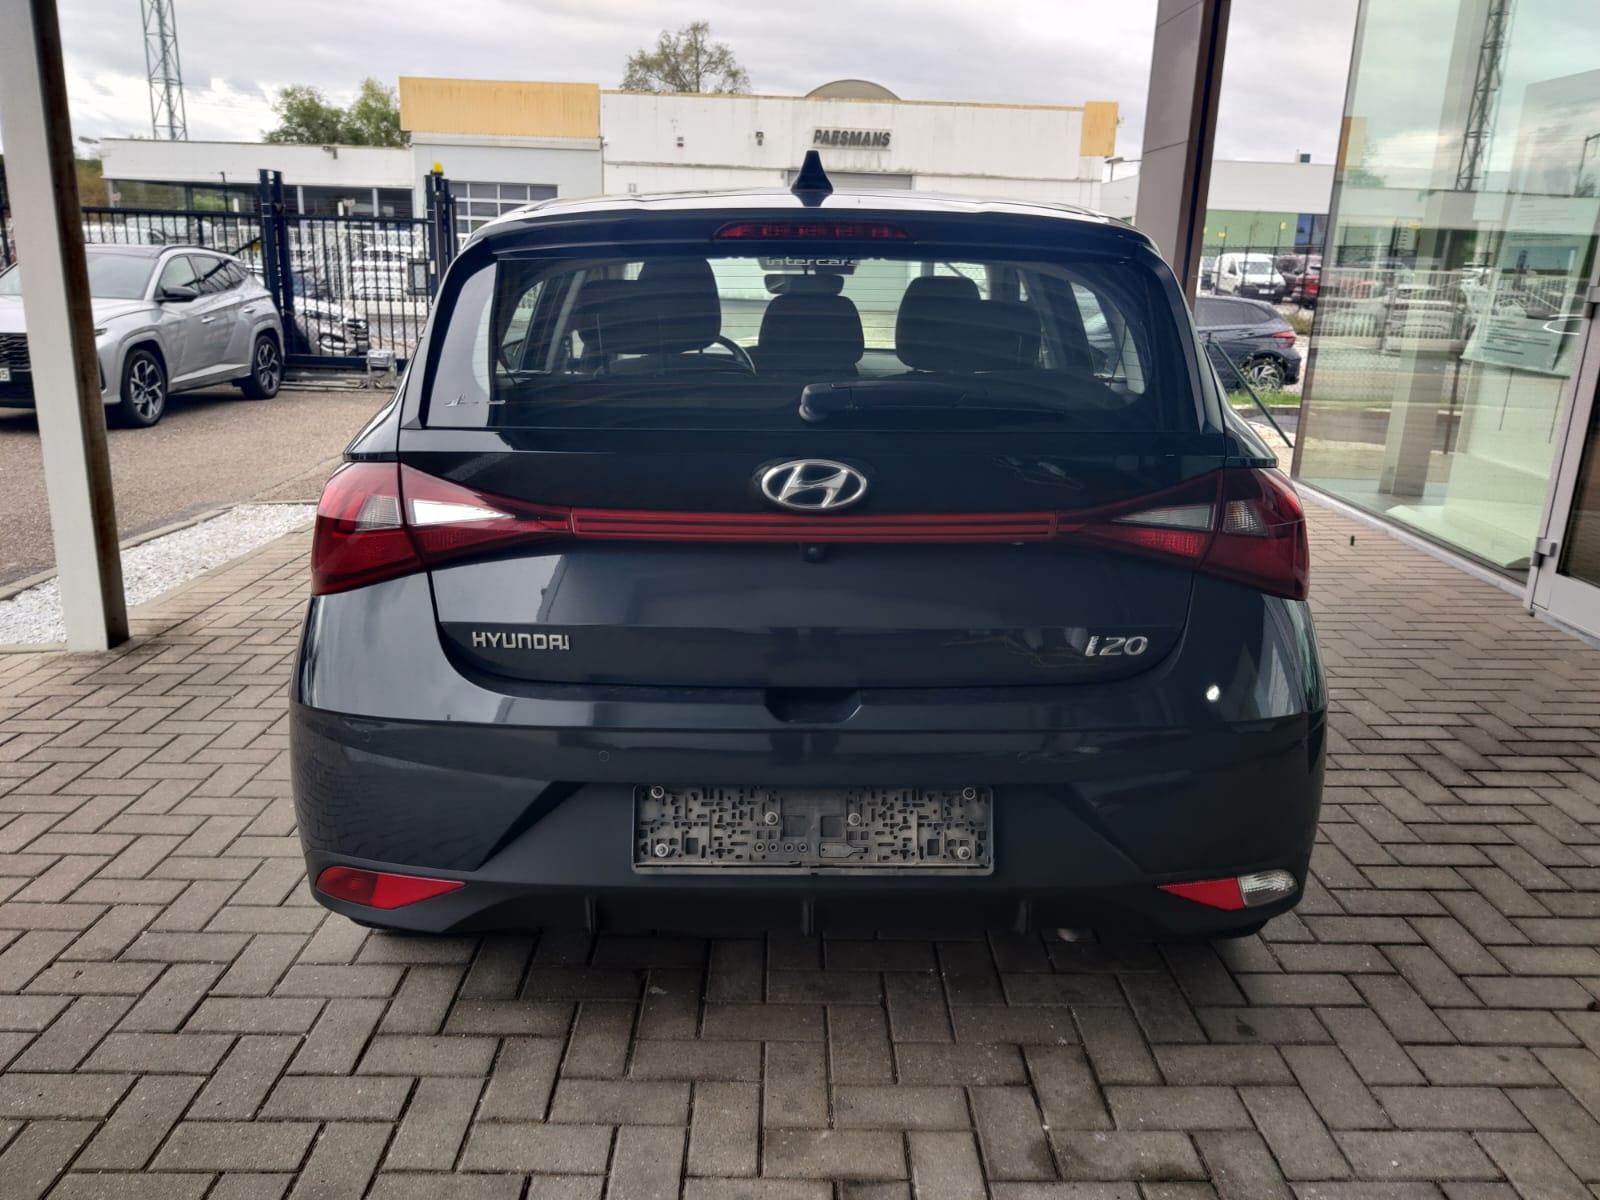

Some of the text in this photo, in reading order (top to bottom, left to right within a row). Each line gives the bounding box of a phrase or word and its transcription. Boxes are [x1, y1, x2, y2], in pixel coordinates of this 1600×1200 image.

[813, 129, 891, 147] PAESMANS
[471, 631, 570, 650] HYUNDAI
[1085, 635, 1148, 656] i20
